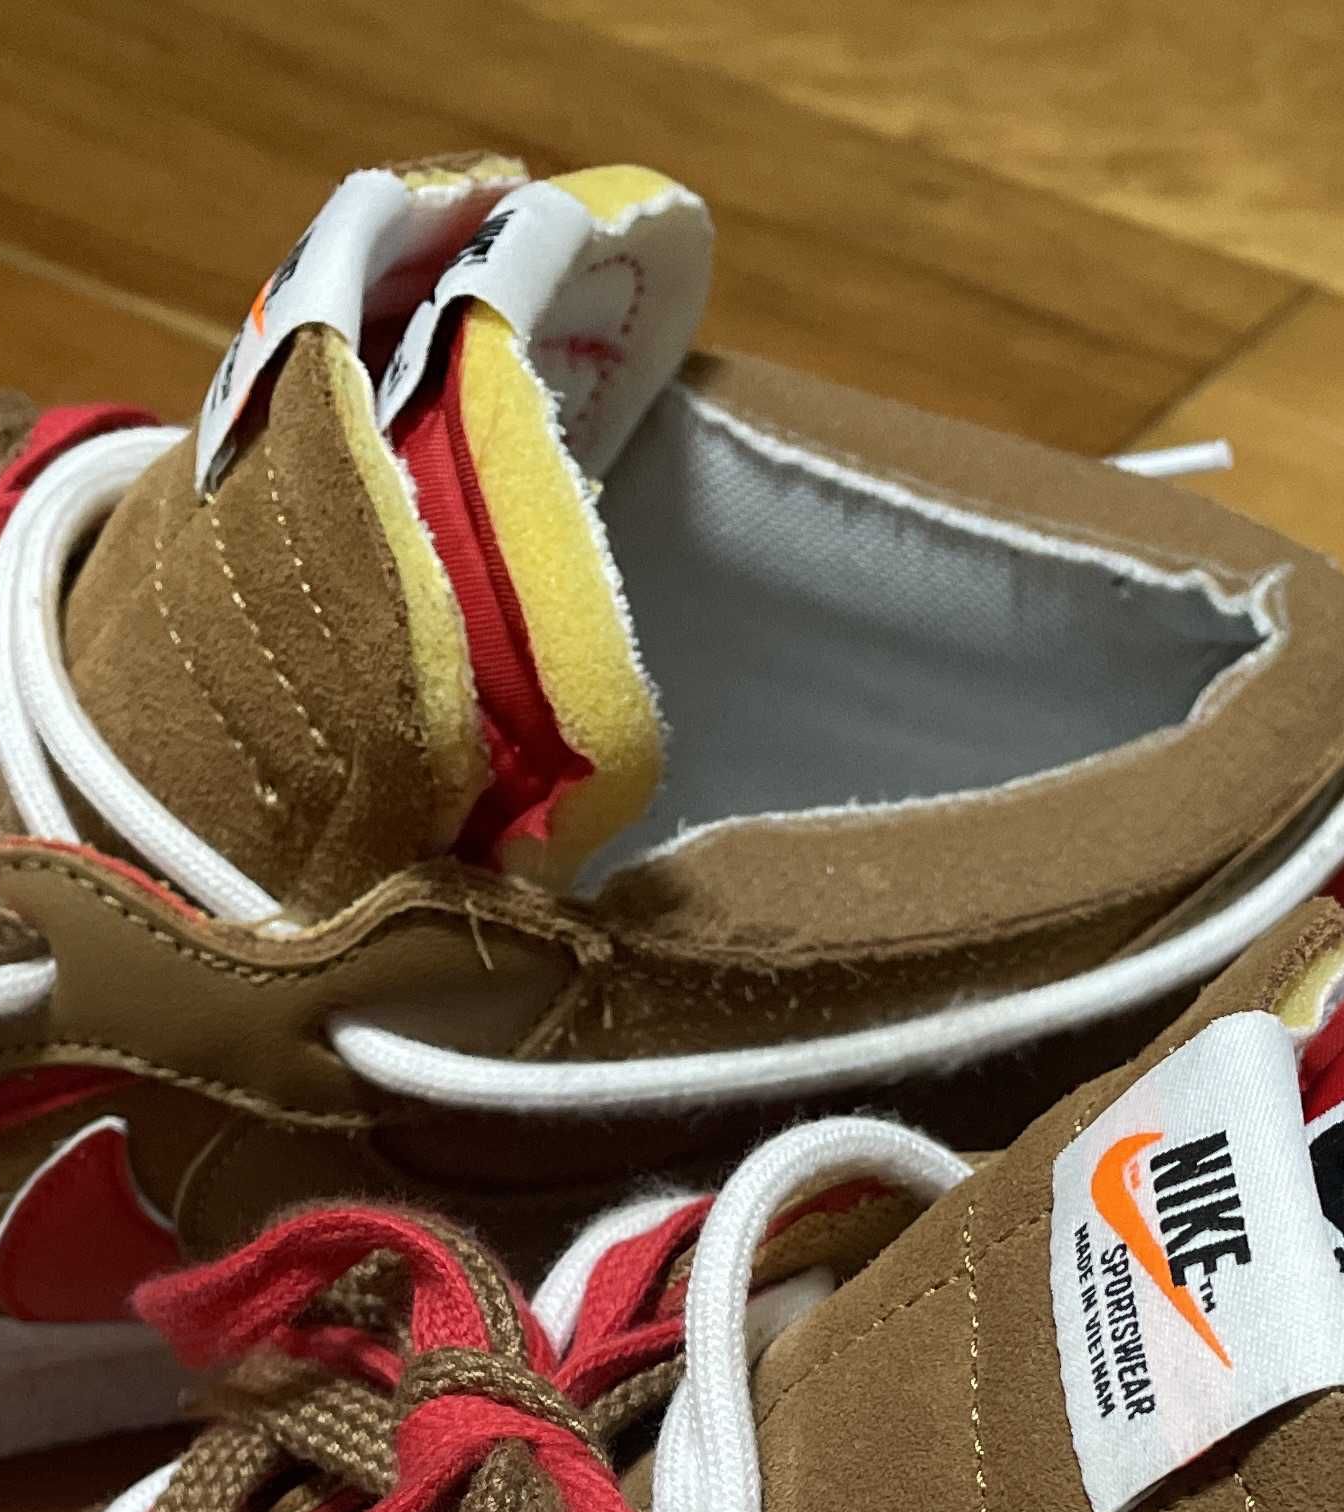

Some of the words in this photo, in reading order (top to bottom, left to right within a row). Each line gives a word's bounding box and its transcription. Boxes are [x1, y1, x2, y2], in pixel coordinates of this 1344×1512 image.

[1074, 1222, 1095, 1284] MADE
[1079, 1286, 1098, 1313] IN
[1100, 1243, 1156, 1420] SPORTSWEAR
[1085, 1311, 1116, 1418] VIETNAM
